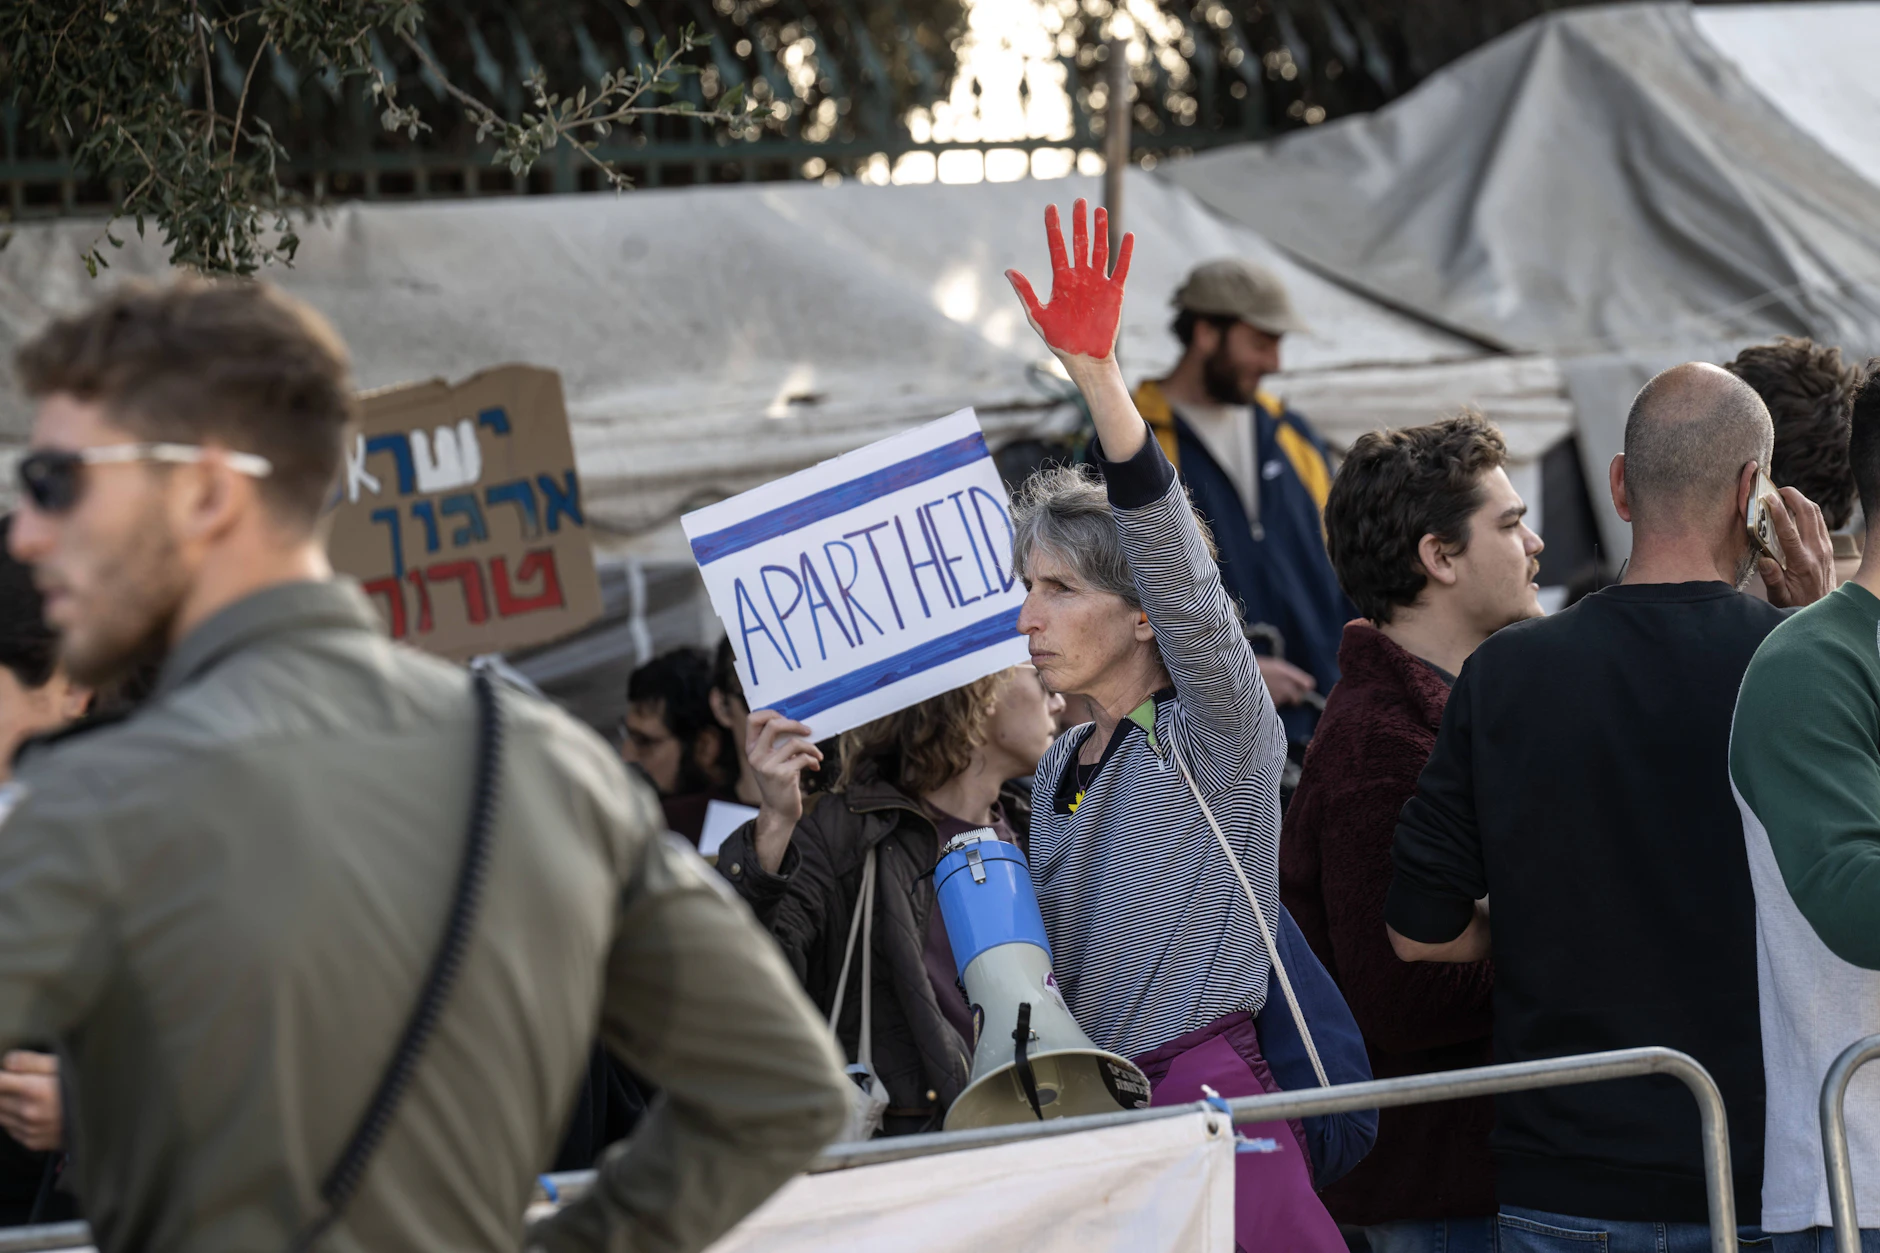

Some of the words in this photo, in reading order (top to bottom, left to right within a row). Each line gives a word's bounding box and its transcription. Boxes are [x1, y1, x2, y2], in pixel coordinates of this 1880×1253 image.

[333, 406, 511, 504] ישרא
[370, 470, 584, 579] ארגון
[361, 548, 565, 640] טרור
[734, 486, 1014, 686] APARTHEID
